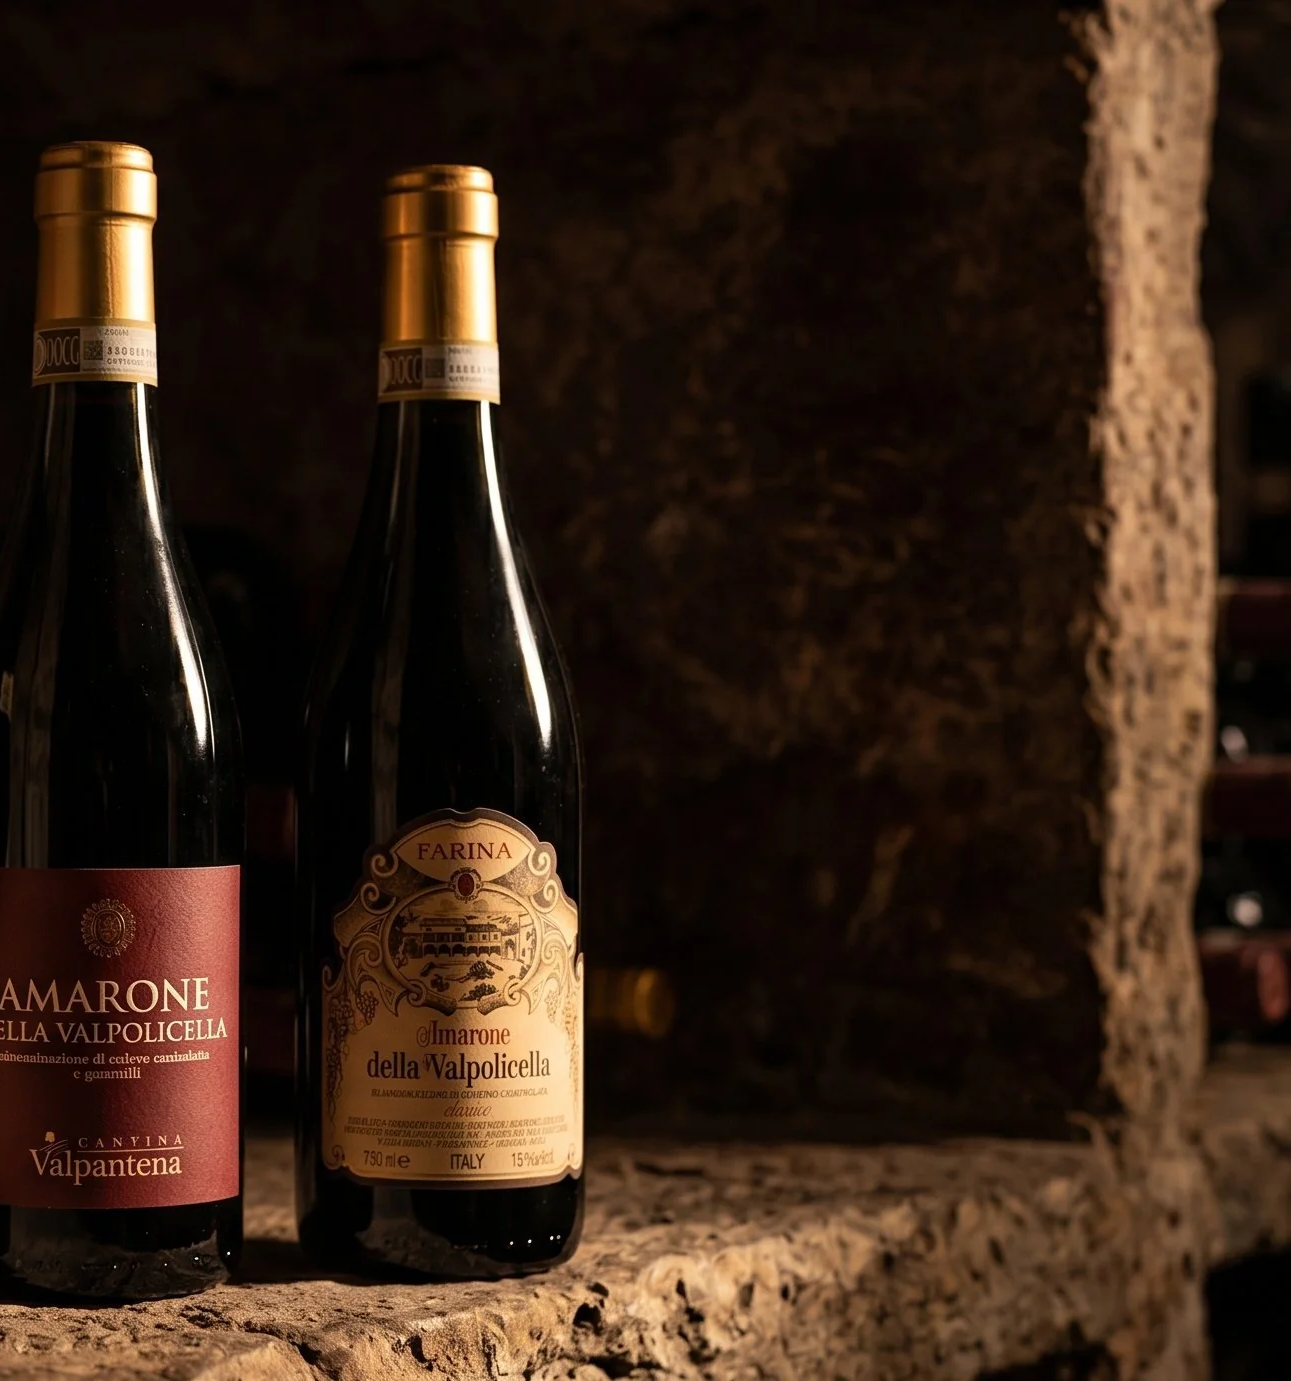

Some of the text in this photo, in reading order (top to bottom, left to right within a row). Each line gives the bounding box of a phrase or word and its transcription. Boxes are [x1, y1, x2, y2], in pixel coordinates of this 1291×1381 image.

[417, 842, 512, 861] FARINA
[56, 1016, 228, 1044] VALPOLICELLA
[366, 1050, 551, 1088] della Valpolicella
[28, 1148, 183, 1186] Valpantena
[450, 1152, 486, 1171] ITALY
